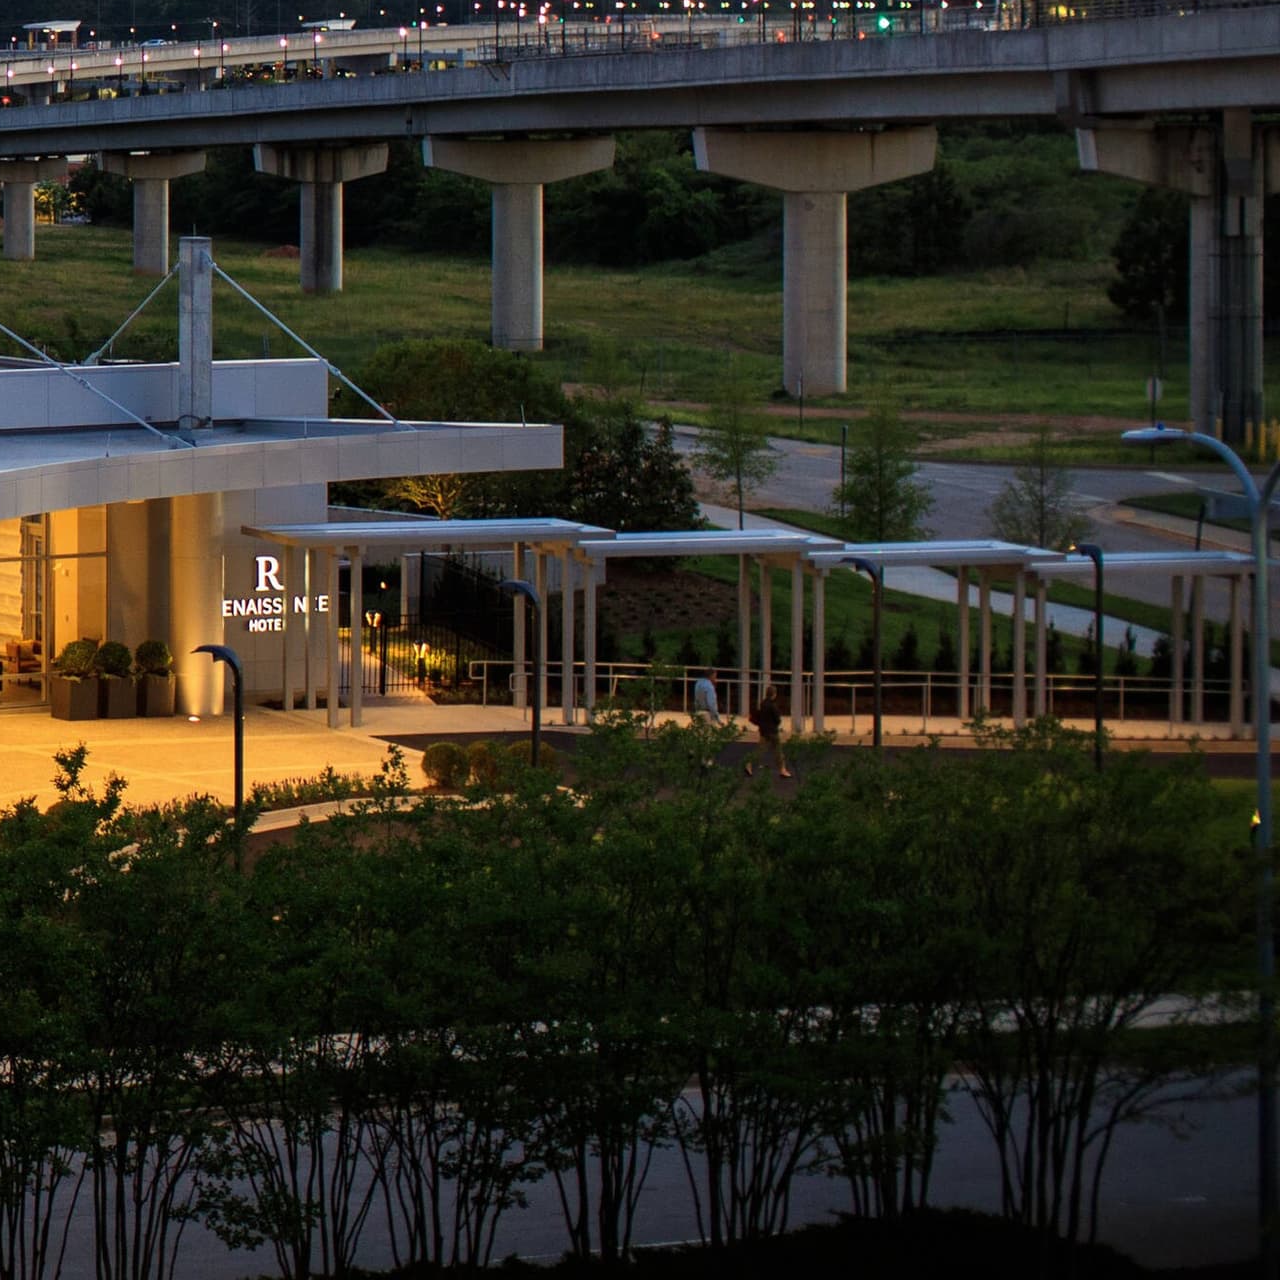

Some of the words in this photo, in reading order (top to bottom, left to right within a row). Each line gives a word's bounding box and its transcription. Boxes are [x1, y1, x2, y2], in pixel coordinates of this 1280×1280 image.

[255, 556, 285, 592] R
[222, 595, 329, 617] ENAISSNE
[249, 618, 283, 632] HOTE
